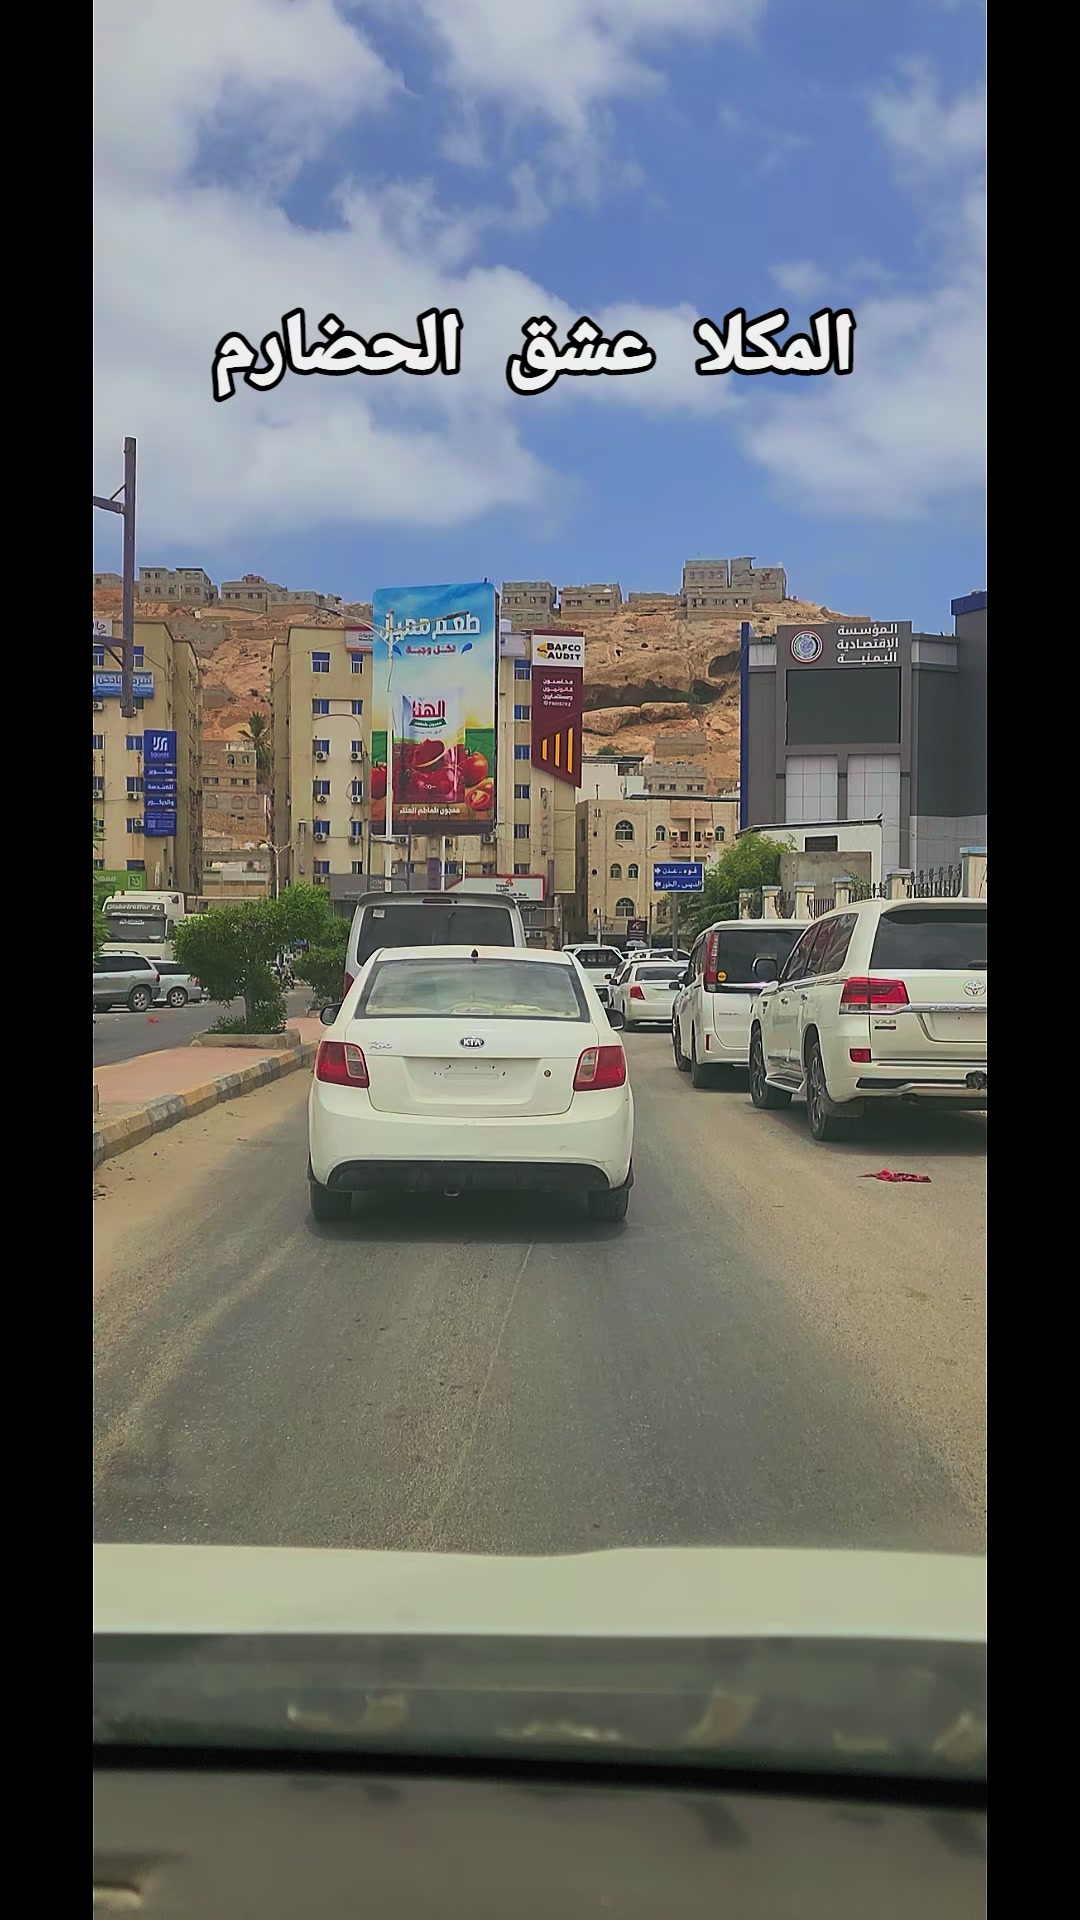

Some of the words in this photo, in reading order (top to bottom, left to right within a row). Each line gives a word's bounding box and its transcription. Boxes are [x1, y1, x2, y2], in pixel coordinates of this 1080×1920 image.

[431, 612, 480, 641] طعم
[837, 623, 898, 637] المؤسسة
[433, 644, 456, 655] لكل
[547, 642, 581, 652] BAFCO
[836, 637, 899, 652] الإقتصادية
[547, 652, 581, 661] AUDIT
[837, 651, 897, 666] اليمنية
[463, 1038, 481, 1046] KIA
